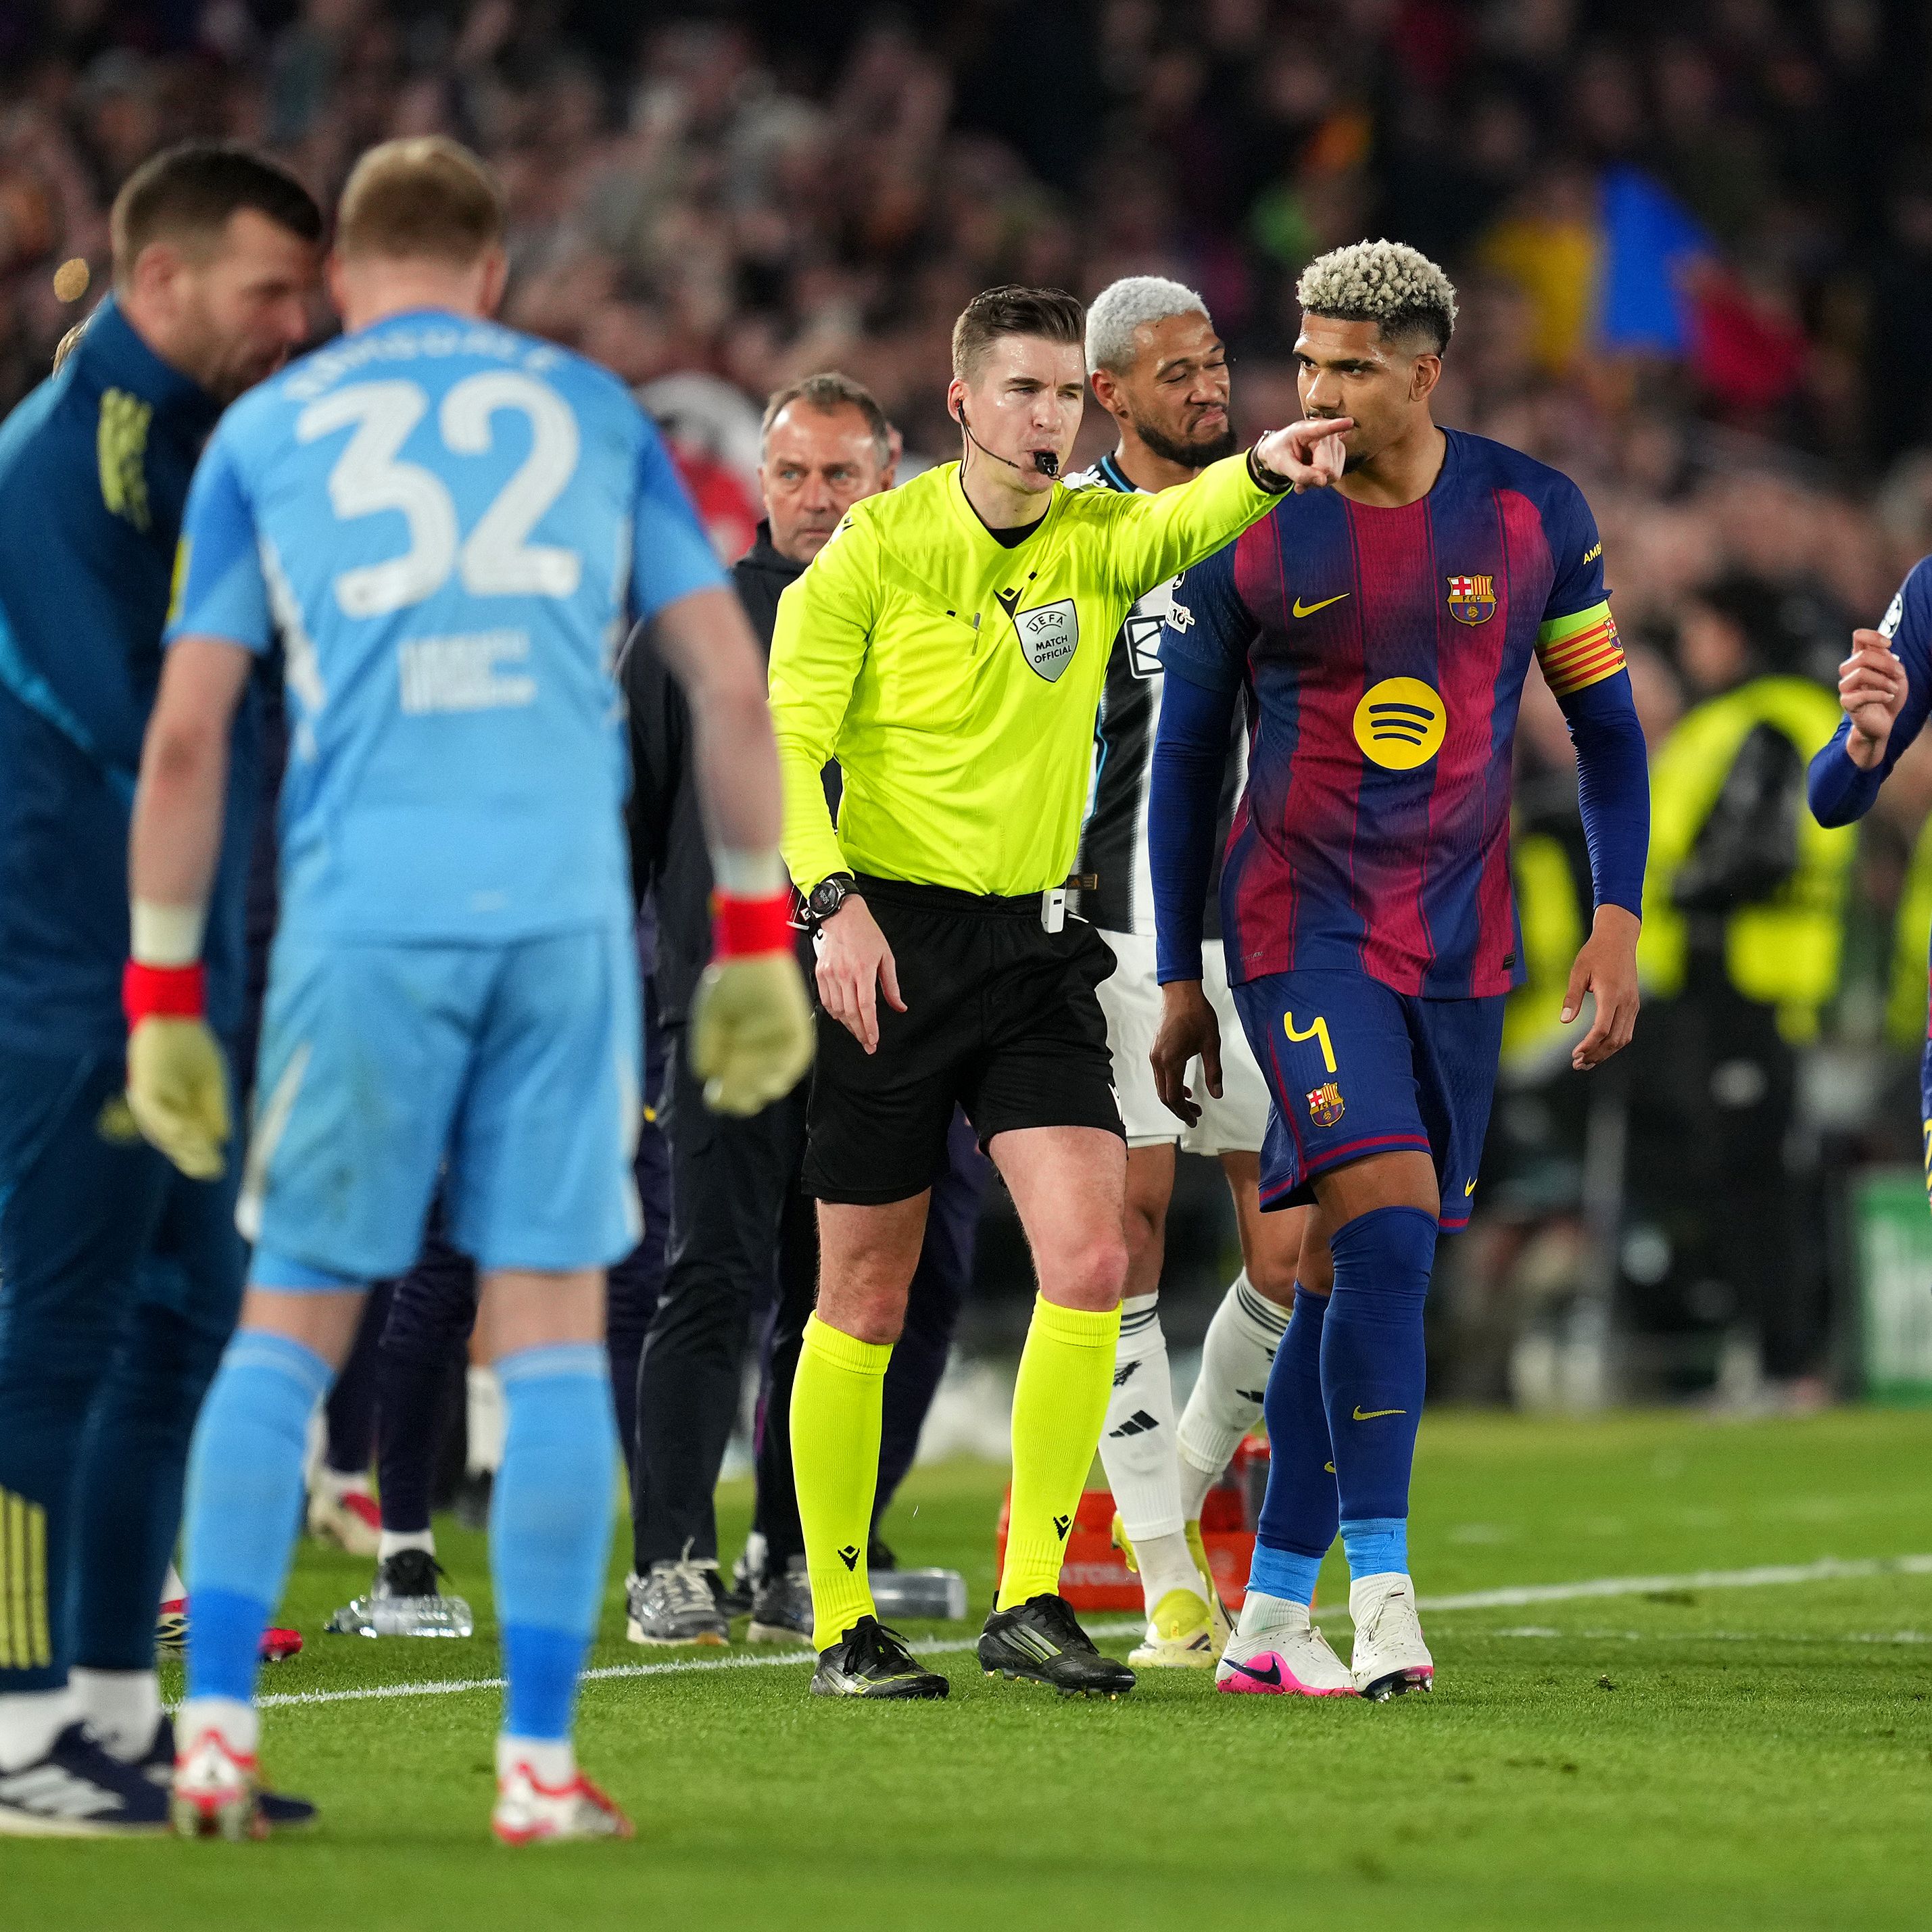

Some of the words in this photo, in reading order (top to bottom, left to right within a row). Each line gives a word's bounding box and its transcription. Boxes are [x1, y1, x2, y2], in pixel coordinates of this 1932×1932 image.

[295, 369, 581, 620] 32
[1029, 613, 1063, 632] UEFA
[1036, 634, 1068, 652] MATCH
[1034, 644, 1072, 664] OFFICIAL
[1283, 1011, 1338, 1073] 4
